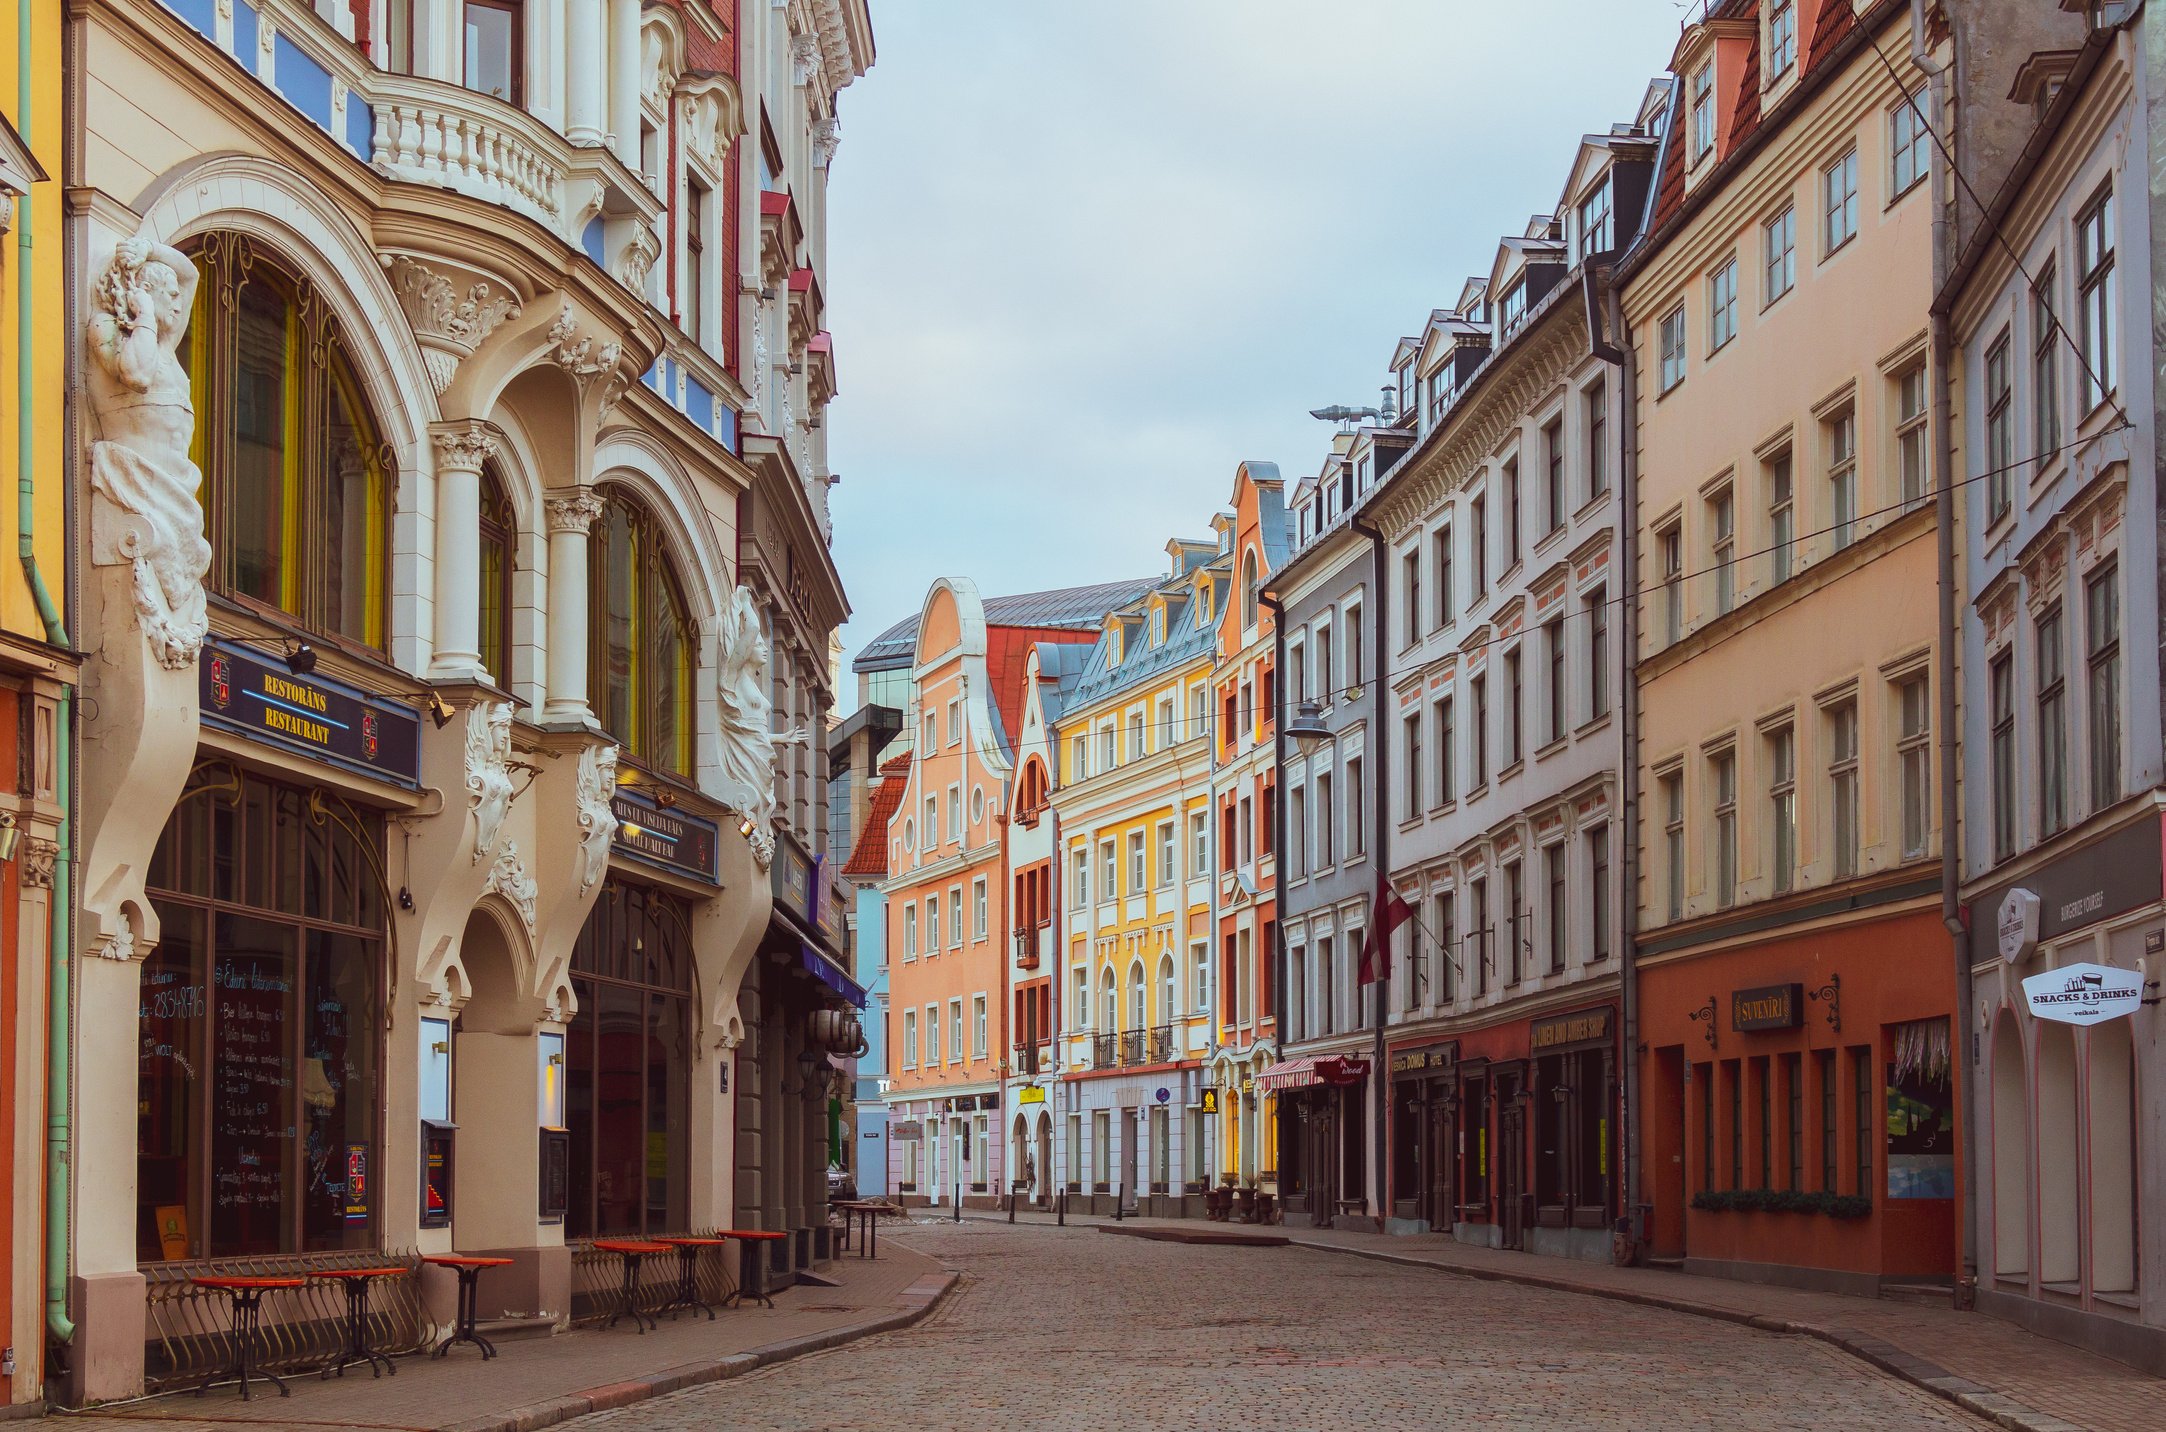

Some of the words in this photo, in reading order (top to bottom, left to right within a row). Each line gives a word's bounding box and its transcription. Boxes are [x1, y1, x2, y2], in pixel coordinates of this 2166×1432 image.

[264, 674, 327, 713] RESTORĀNS
[265, 707, 330, 745] RESTAURANT
[2033, 993, 2080, 1004] SNACKS
[2082, 992, 2089, 1000] &
[2092, 989, 2137, 1000] DRINKS
[1742, 997, 1782, 1021] SUVENĪRI
[2073, 1009, 2099, 1017] veikals
[155, 1044, 173, 1057] WOLT
[1407, 1052, 1425, 1070] DOMUS
